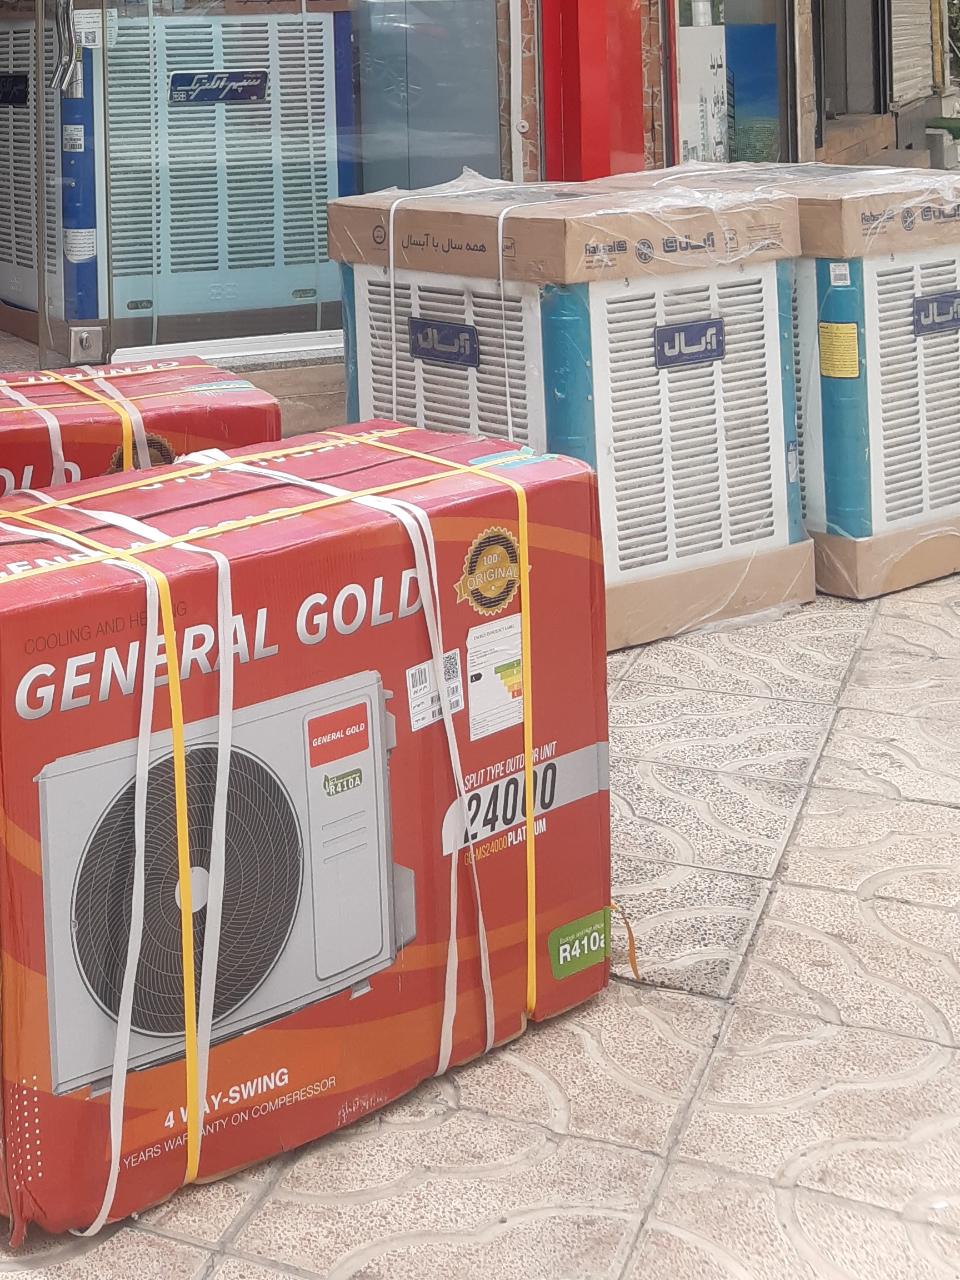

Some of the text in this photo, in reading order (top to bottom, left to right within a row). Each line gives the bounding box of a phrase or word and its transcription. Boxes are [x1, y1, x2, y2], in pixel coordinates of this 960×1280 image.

[401, 233, 487, 253] همه سال با آبسال
[466, 565, 519, 591] ORIGINAL
[296, 568, 424, 645] GOLD
[24, 600, 187, 656] COOLING AND HENG
[312, 723, 365, 747] GENERAL GOLD
[464, 740, 558, 792] SPLIT TYPE OUTDR UNIT
[330, 776, 361, 795] R410A
[507, 817, 547, 849] PLATUM
[123, 1144, 162, 1169] YEARS
[164, 1119, 230, 1151] WARANTY
[231, 1112, 249, 1130] ON
[251, 1076, 337, 1118] COMPERESSOR
[164, 1111, 175, 1129] 4
